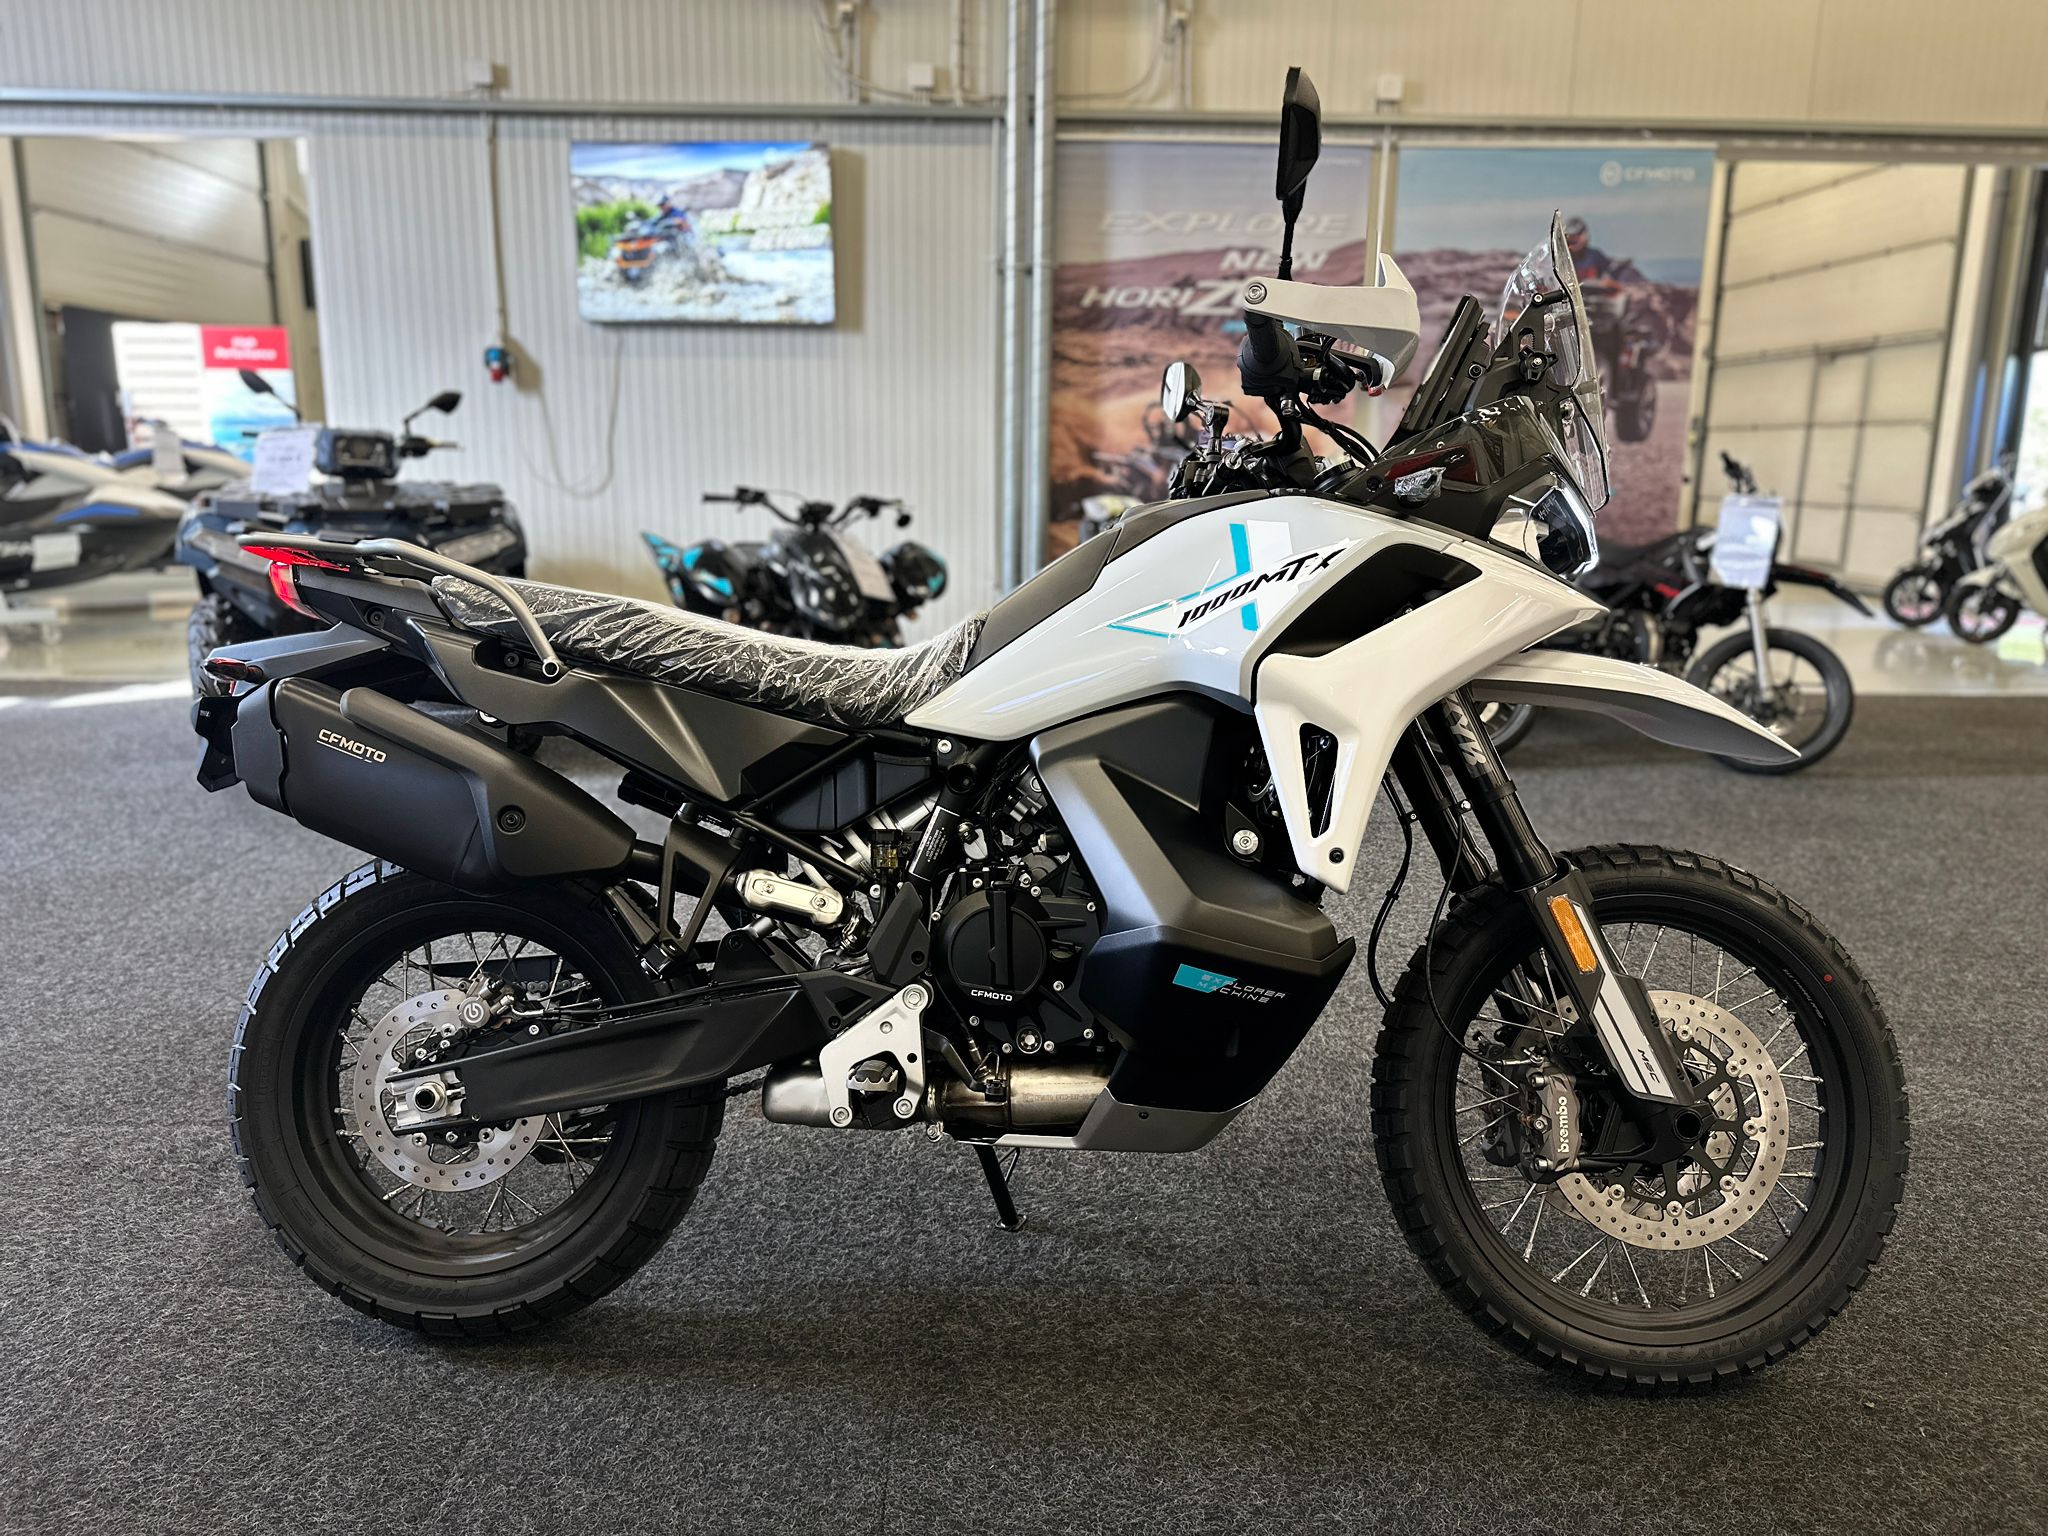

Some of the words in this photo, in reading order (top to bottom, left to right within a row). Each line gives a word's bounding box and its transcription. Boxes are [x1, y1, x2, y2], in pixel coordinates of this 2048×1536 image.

[1624, 166, 1696, 181] CFMOTO
[1101, 210, 1347, 234] EXPLORE
[1220, 250, 1329, 270] NEW
[318, 728, 387, 763] CFMOTO
[970, 989, 1013, 1002] CFMOTO
[1196, 981, 1270, 1003] MACHINE
[1201, 973, 1286, 999] EXPLORER
[1555, 1096, 1570, 1153] brembo
